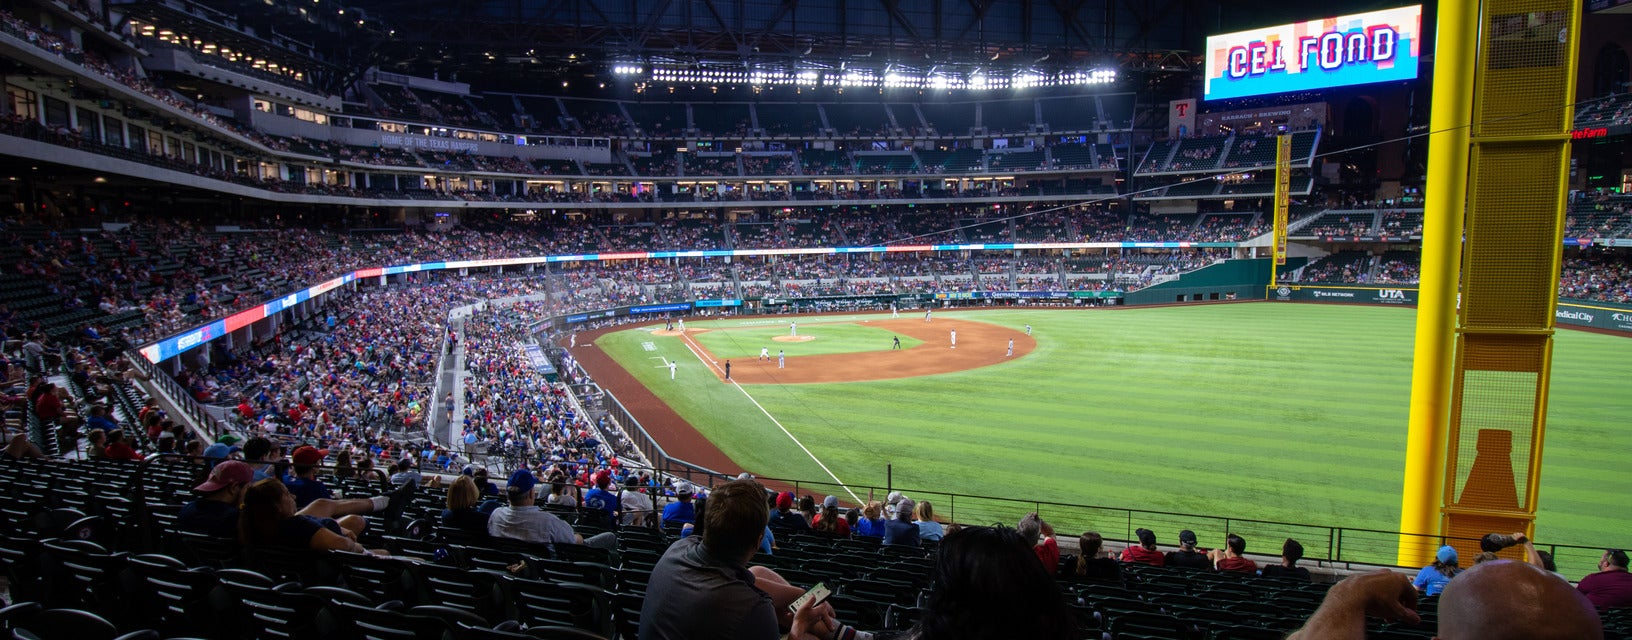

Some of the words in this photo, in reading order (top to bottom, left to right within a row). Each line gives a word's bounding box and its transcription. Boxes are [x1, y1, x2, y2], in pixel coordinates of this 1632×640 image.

[1175, 103, 1188, 118] T
[1258, 109, 1292, 118] BREWING
[382, 135, 403, 145] HOME
[404, 137, 414, 146] OF
[415, 138, 427, 148] THE
[429, 139, 449, 149] TEXAS
[450, 141, 478, 152] RANGERS
[1379, 289, 1405, 299] UTA
[1578, 312, 1594, 323] City
